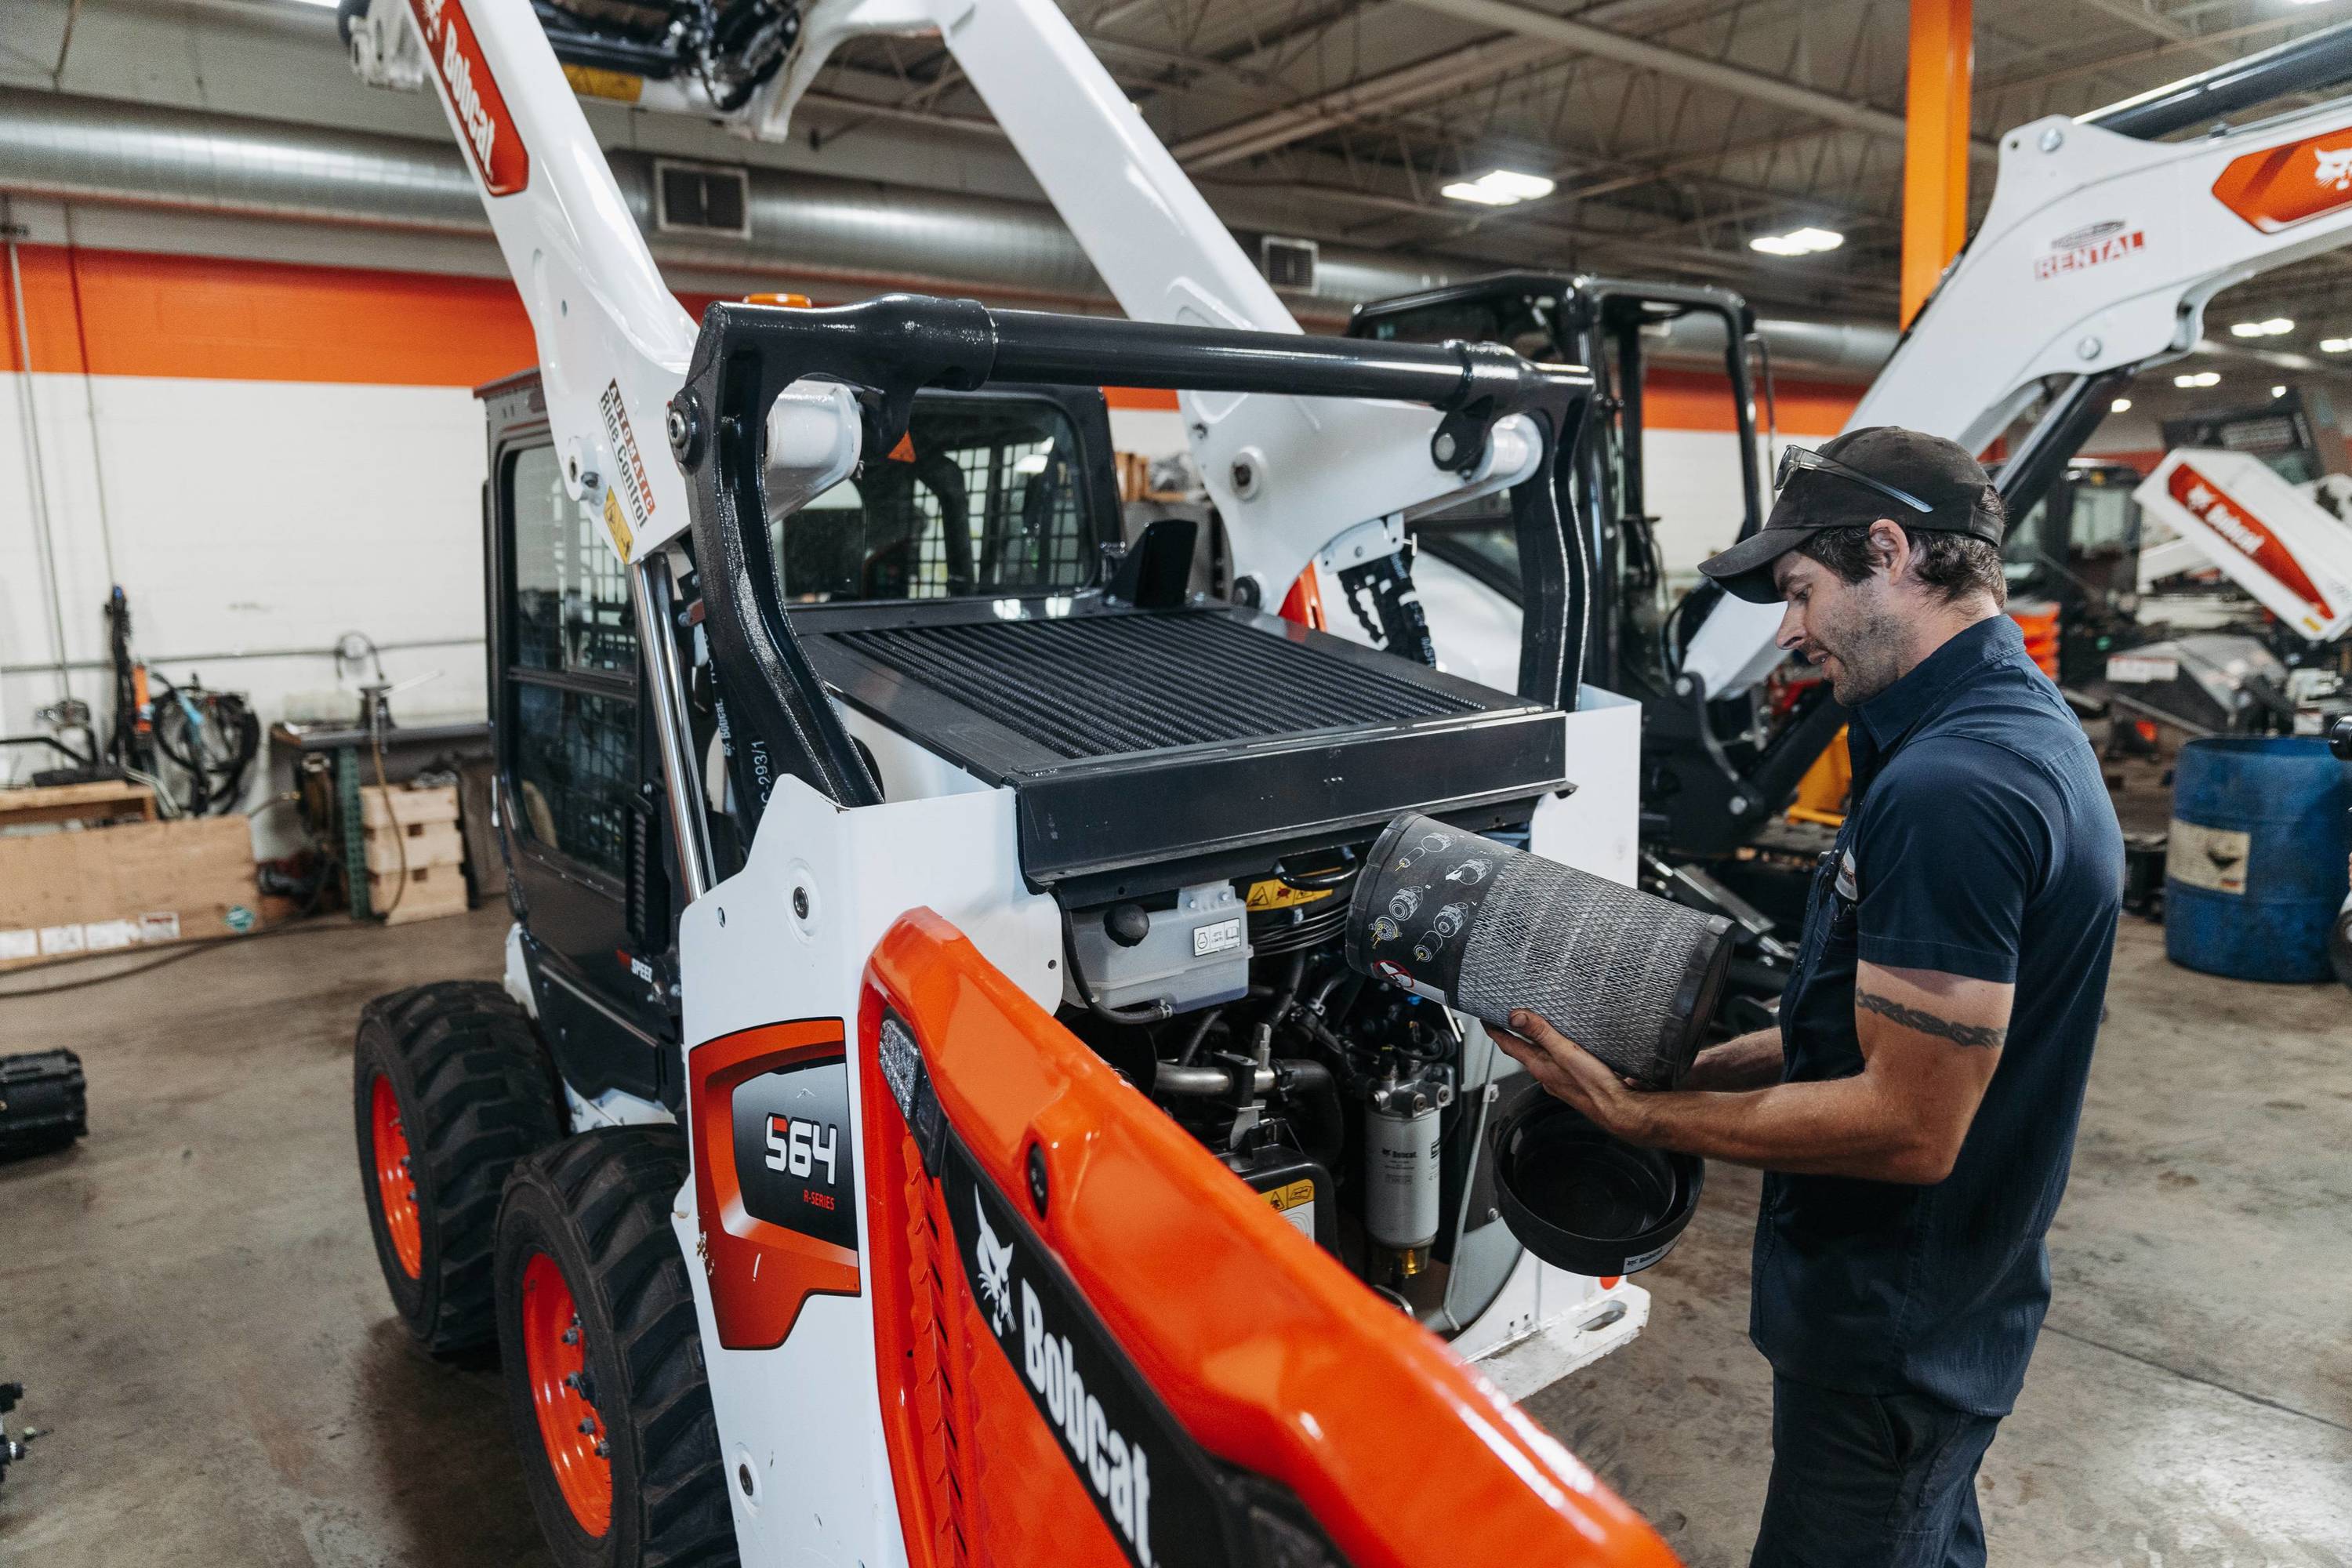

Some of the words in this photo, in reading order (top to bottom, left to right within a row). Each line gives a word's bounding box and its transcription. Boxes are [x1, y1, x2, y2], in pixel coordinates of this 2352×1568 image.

[443, 18, 495, 179] Bobcat
[2035, 231, 2146, 281] RENTAL
[601, 390, 620, 443] Ride
[617, 445, 648, 528] Control
[609, 383, 654, 512] AUTOMATIC
[2206, 502, 2265, 556] Bobcat
[764, 1114, 837, 1185] S64
[802, 1189, 835, 1211] R-SERIES
[1022, 1277, 1152, 1568] Bobcat
